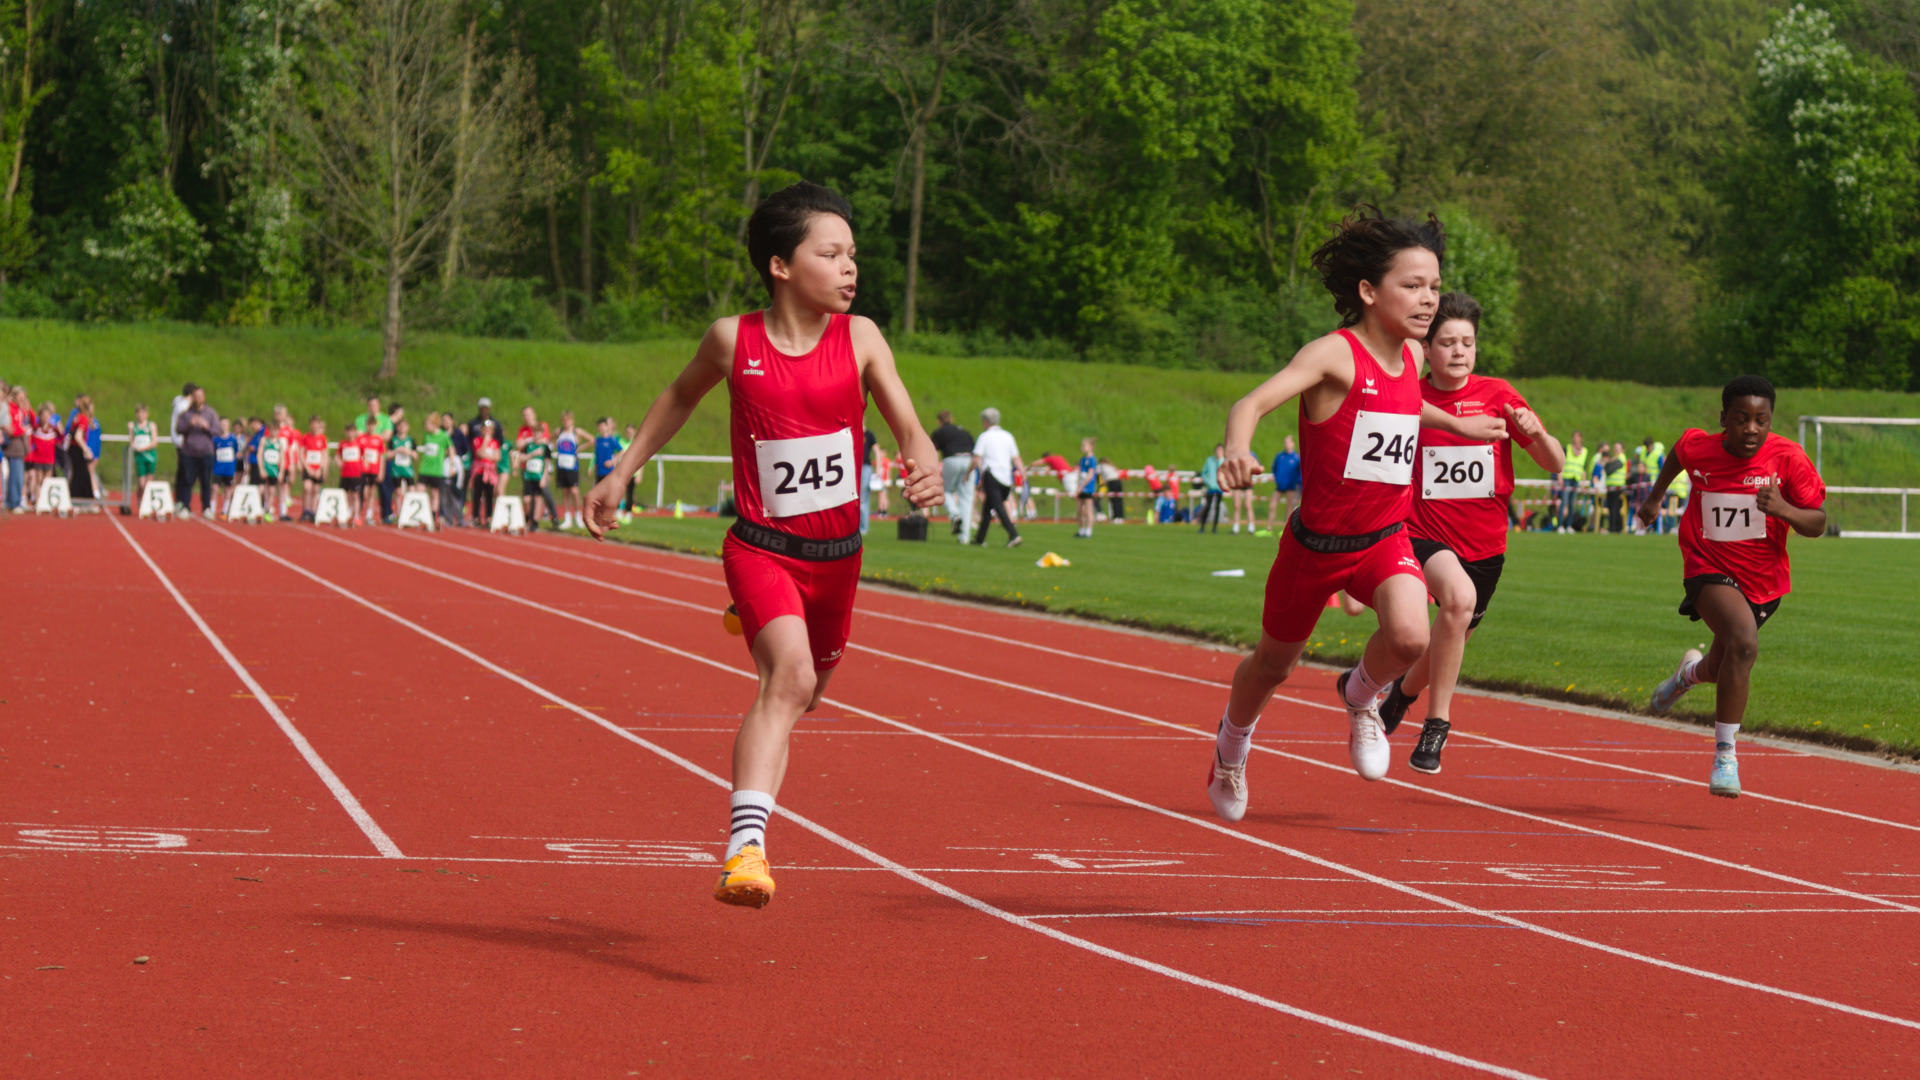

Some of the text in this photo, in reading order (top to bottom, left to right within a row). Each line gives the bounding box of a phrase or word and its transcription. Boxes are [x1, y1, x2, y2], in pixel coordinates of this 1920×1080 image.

[1362, 432, 1415, 465] 246
[773, 453, 844, 495] 245
[1433, 461, 1484, 484] 260
[47, 484, 62, 507] 6
[150, 487, 164, 510] 5
[240, 491, 254, 512] 4
[326, 495, 340, 517] 3
[409, 499, 424, 521] 2
[505, 503, 514, 526] 1
[1711, 507, 1750, 528] 171
[801, 533, 860, 557] erima
